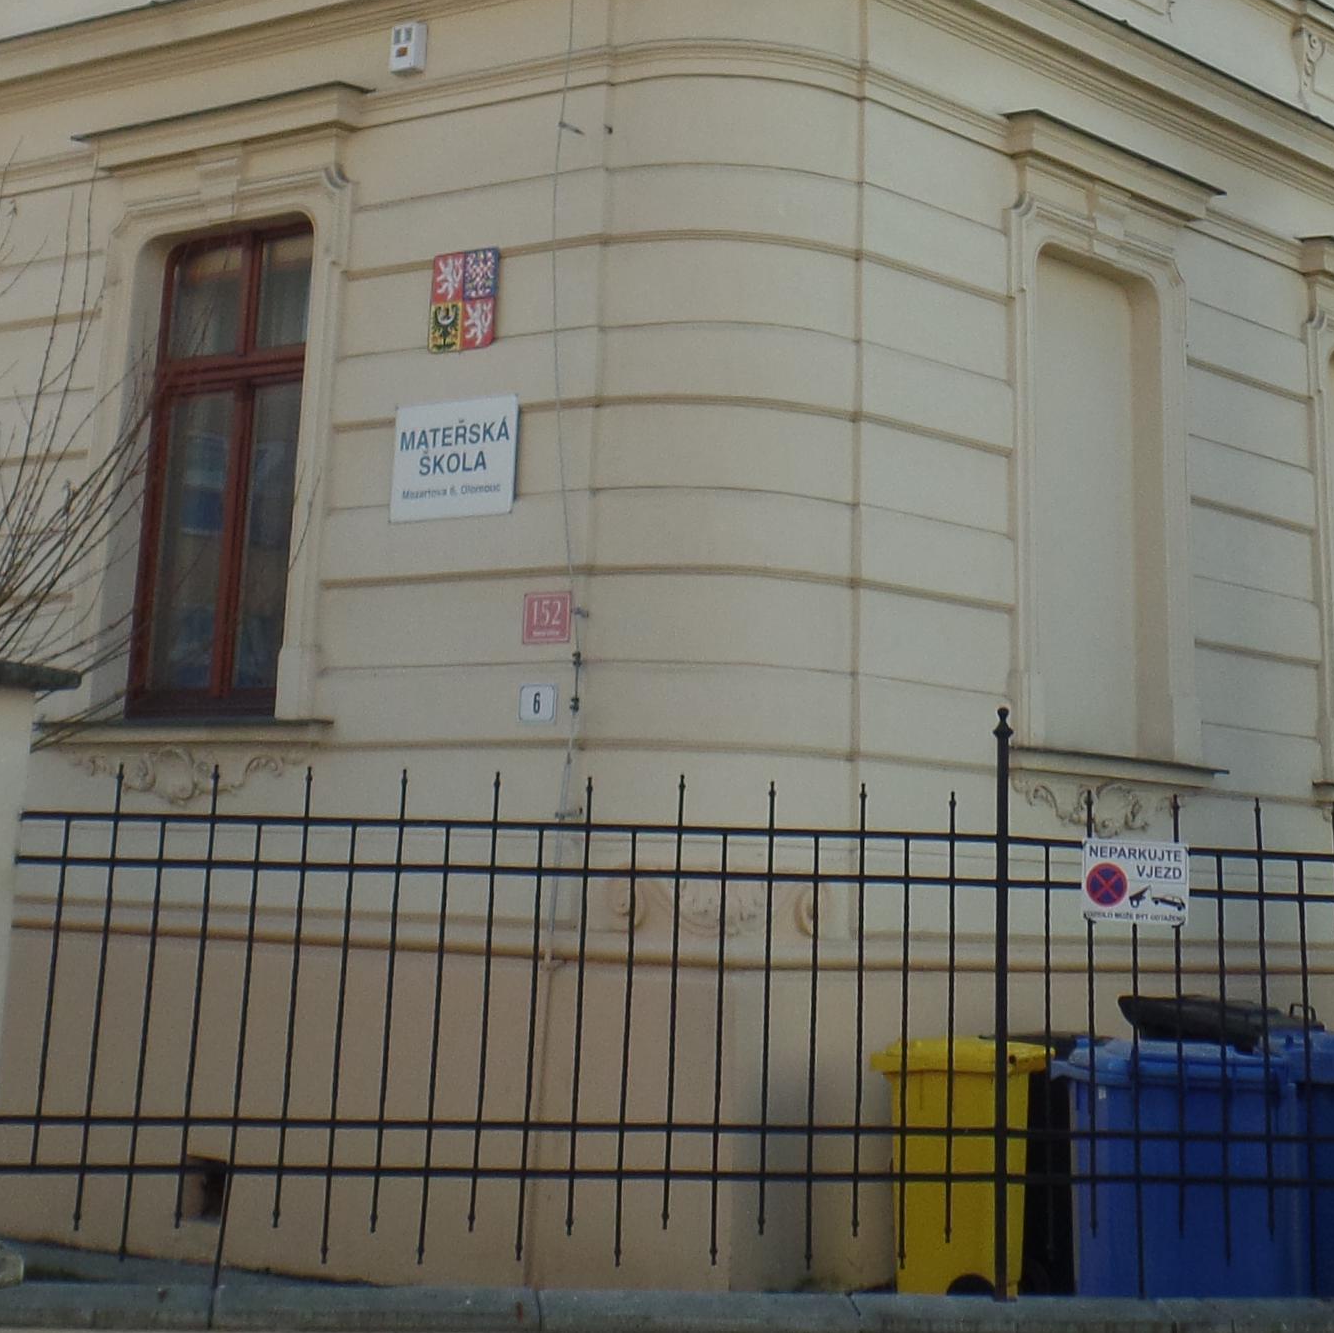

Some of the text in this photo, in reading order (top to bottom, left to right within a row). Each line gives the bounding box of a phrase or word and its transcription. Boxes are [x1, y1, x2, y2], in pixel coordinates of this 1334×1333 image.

[400, 416, 509, 451] MATEŘSKÁ
[419, 450, 486, 476] ŠKOLA
[461, 483, 501, 495] Olomouc
[533, 600, 561, 626] 152
[533, 692, 541, 714] 6
[1089, 845, 1182, 862] NEPARKUJTE
[1136, 865, 1182, 880] VJEZD
